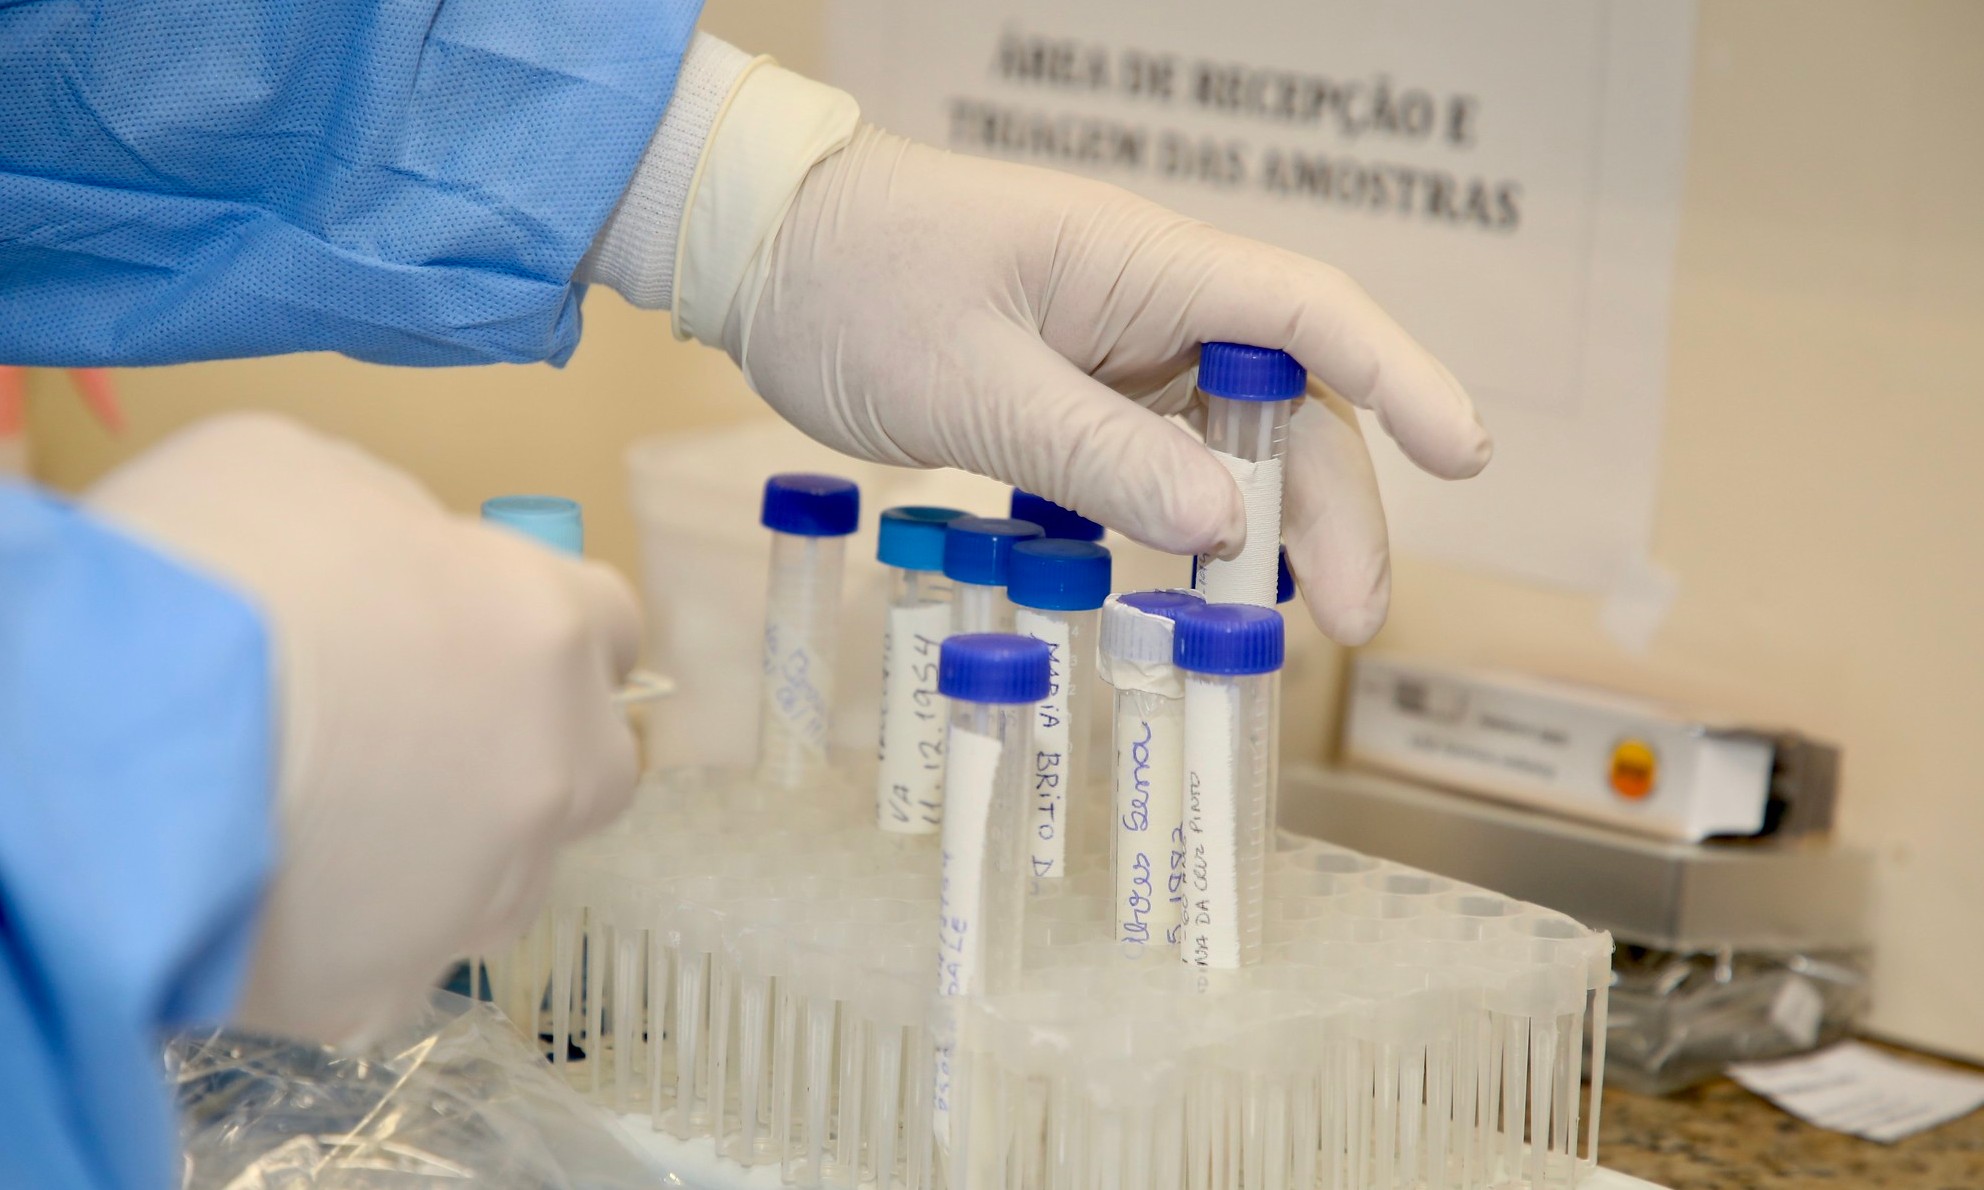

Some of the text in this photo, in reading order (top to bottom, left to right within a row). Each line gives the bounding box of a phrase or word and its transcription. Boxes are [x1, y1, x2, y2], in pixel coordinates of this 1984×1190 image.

[1123, 47, 1176, 98] DE
[1190, 55, 1435, 141] RECEPÇÃO
[1446, 95, 1480, 147] E
[1157, 132, 1247, 187] DAS
[1262, 148, 1522, 232] AMOSTRAS
